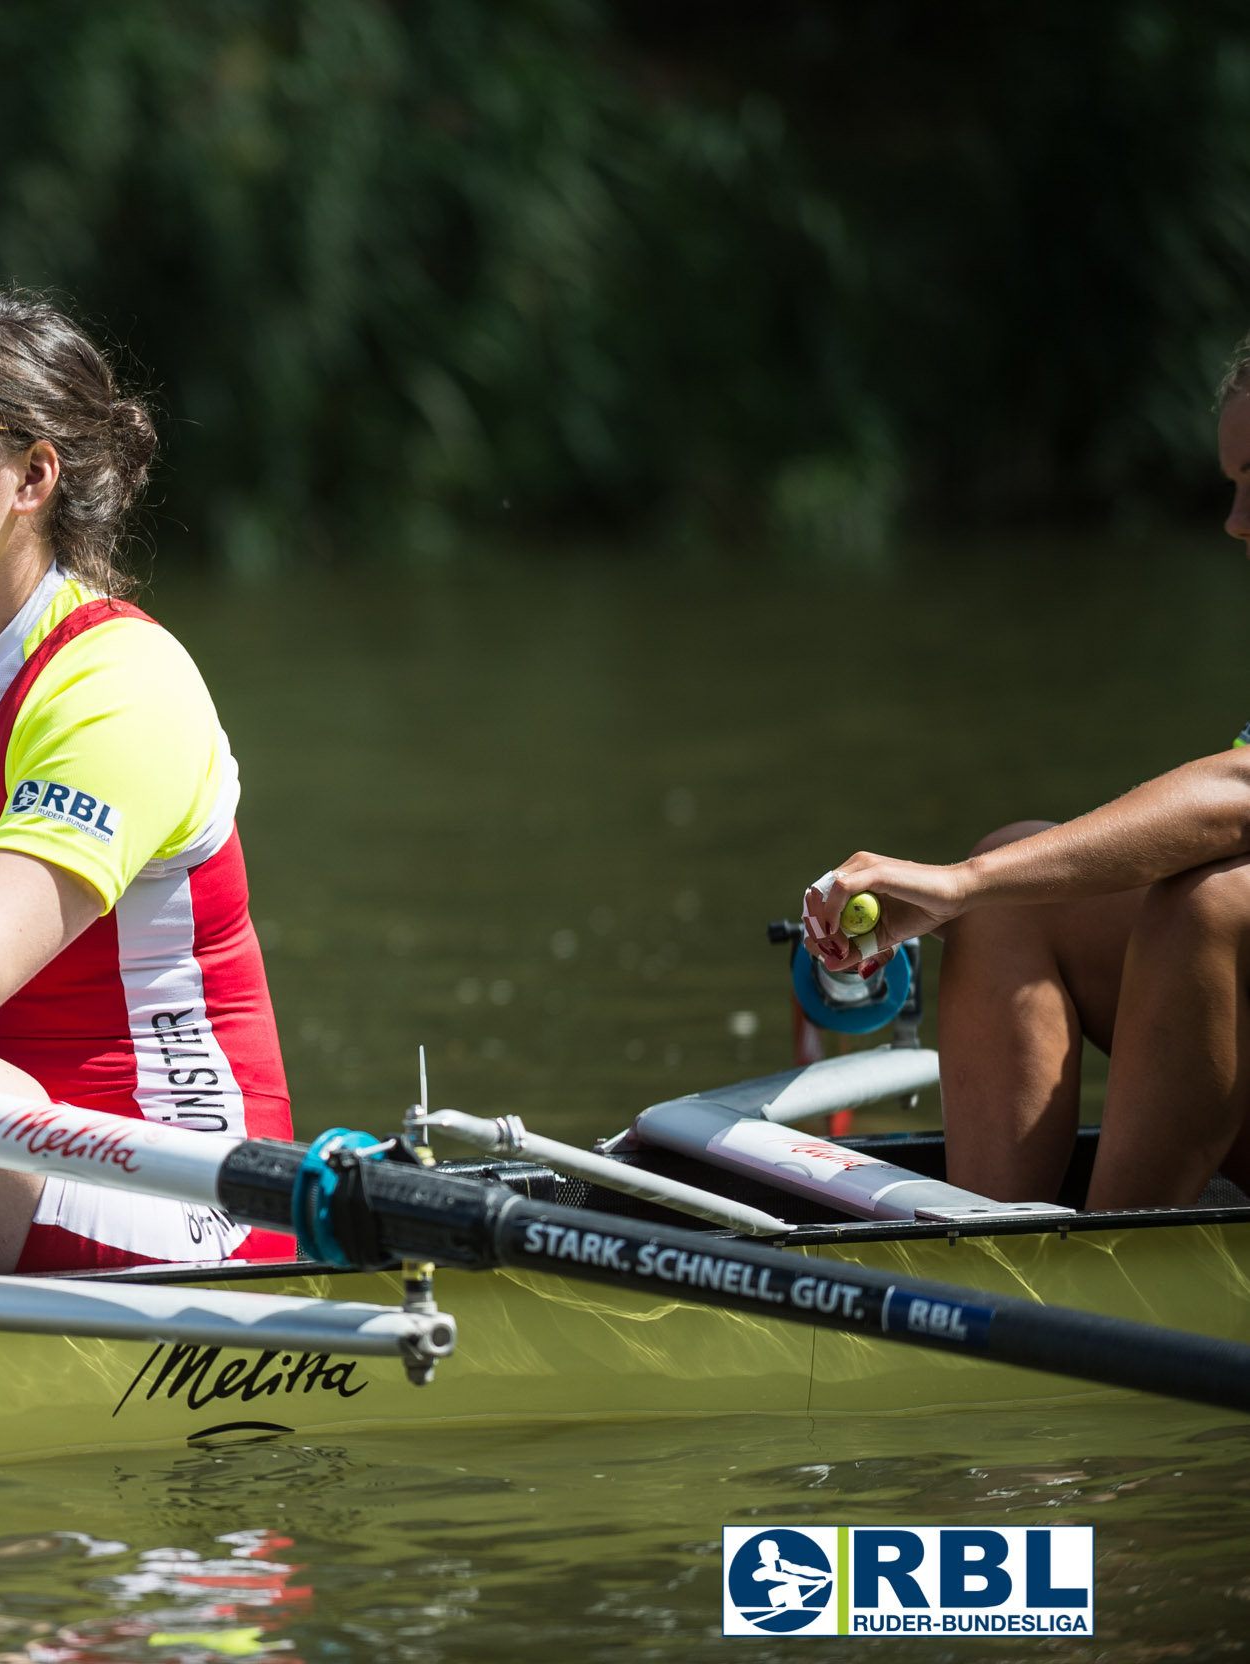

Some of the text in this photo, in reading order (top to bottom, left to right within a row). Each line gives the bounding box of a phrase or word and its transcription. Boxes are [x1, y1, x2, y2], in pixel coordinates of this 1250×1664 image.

[37, 808, 111, 844] RUDER-BUNDESLIGA
[41, 783, 114, 836] RBL
[151, 1007, 228, 1132] ÜNSTER
[524, 1222, 967, 1333] STARK. SCHNELL. GUT. RBL
[112, 1342, 369, 1418] Melitta
